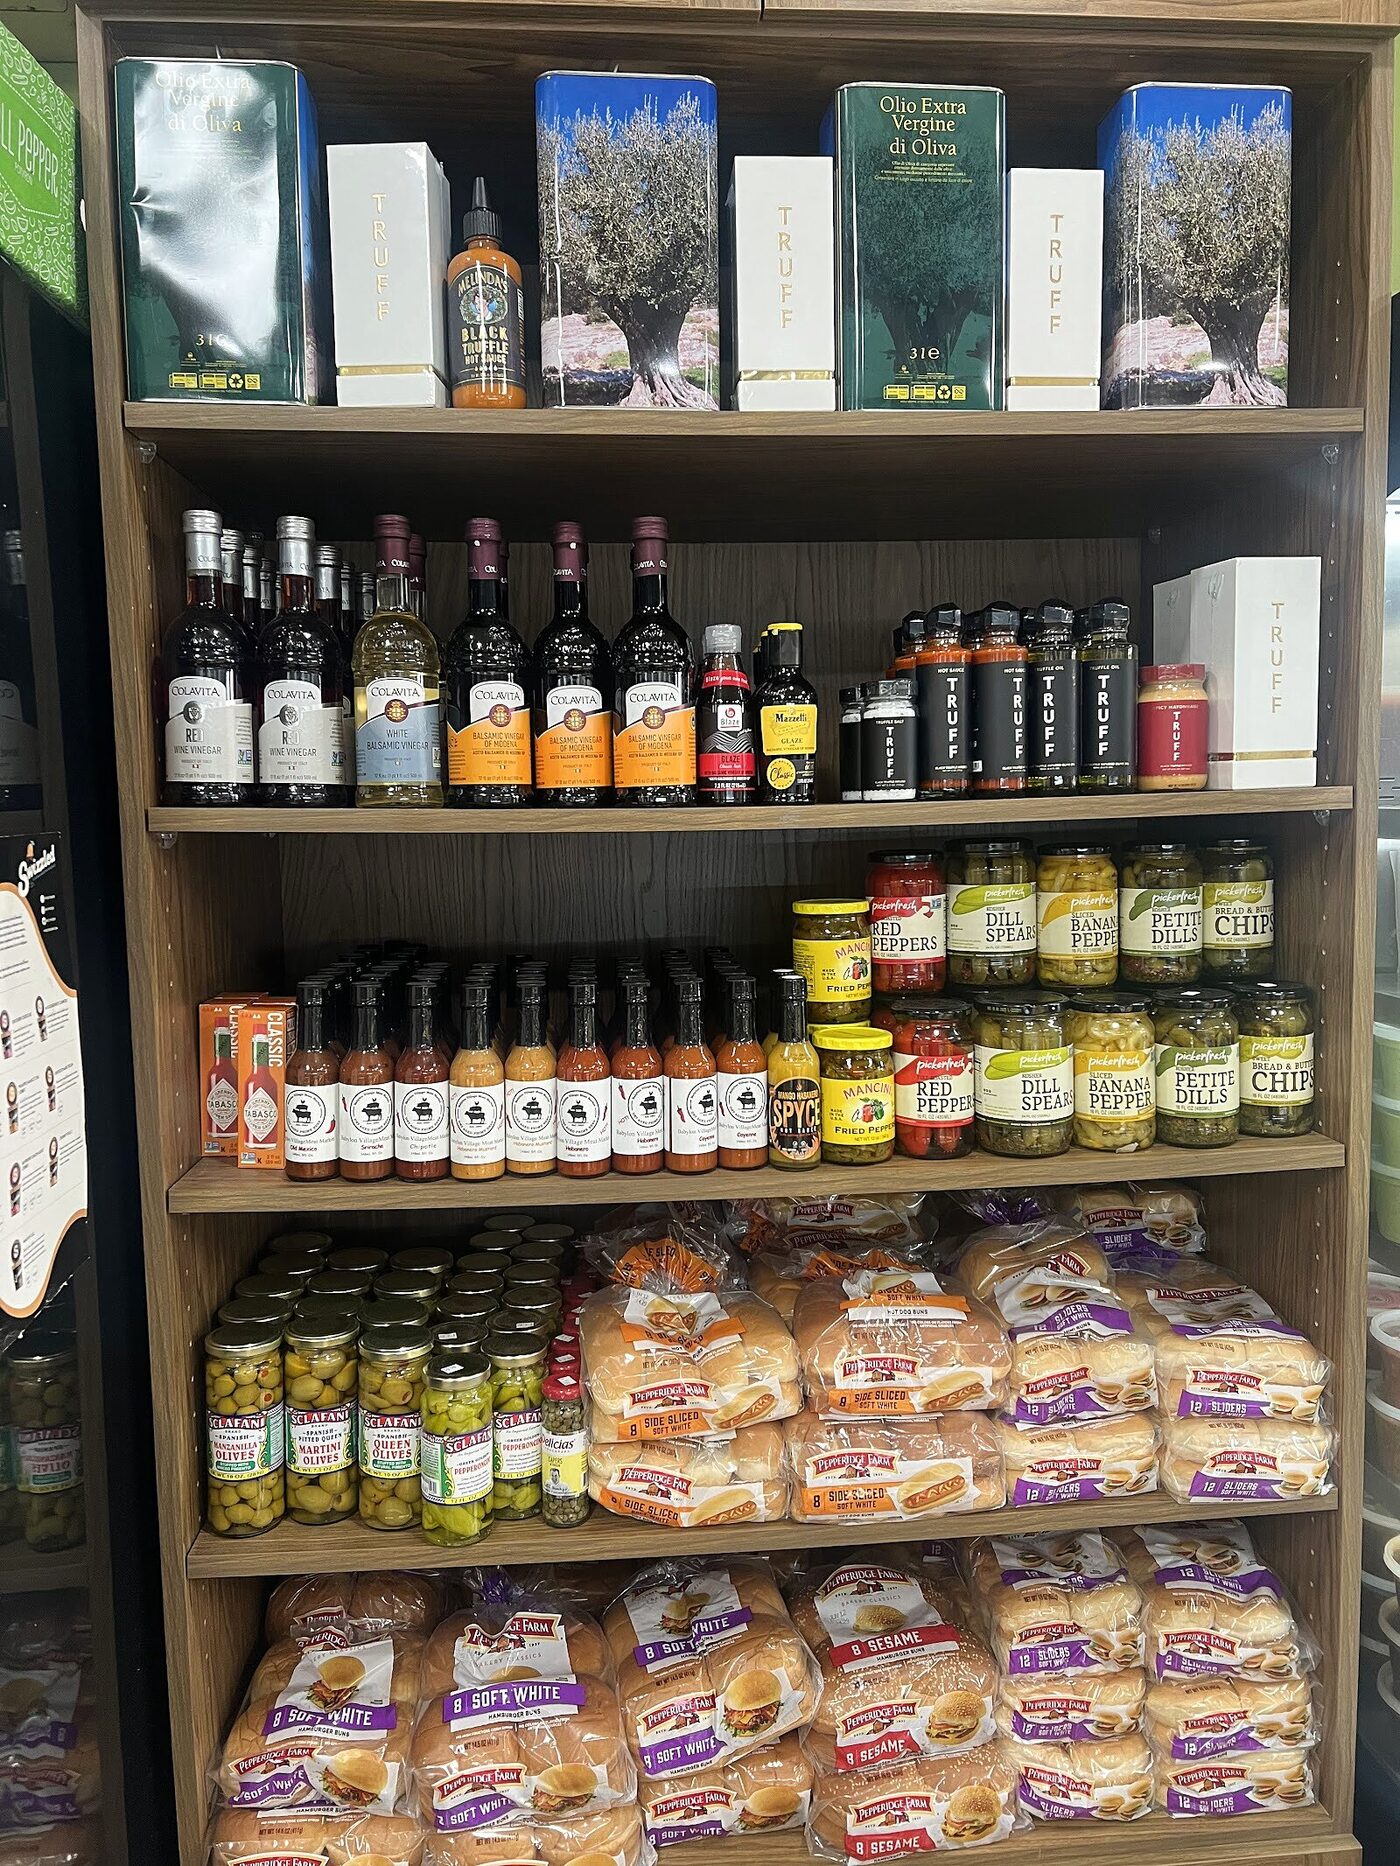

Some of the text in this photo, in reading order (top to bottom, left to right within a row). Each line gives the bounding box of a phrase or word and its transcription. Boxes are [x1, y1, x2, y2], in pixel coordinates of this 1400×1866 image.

[880, 96, 967, 115] Olio Extra
[891, 114, 956, 137] Vergine
[889, 137, 957, 156] di Oliva
[372, 193, 390, 321] TRUFF
[777, 205, 793, 329] TRUFF
[1049, 213, 1064, 334] TRUFF
[461, 325, 509, 342] BLACK
[462, 340, 509, 356] TRUFFLE
[1271, 602, 1285, 714] TRUFF
[172, 686, 220, 697] COLAVITA
[267, 689, 316, 700] COLAVITA
[371, 687, 420, 697] COLAVITA
[475, 690, 521, 701] COLAVITA
[629, 692, 676, 703] COLAVITA
[550, 695, 597, 706] COLAVITA
[720, 718, 740, 726] Blaze
[946, 677, 959, 759] TRUFF
[1012, 677, 1024, 759] TRUFF
[1042, 675, 1055, 758] TRUFF
[1097, 674, 1110, 756] TRUFF
[386, 729, 408, 738] WHITE
[473, 732, 525, 740] BALSAMIC VINEGAR
[1172, 711, 1181, 762] TRUFF
[173, 745, 222, 755] WINE VINEGAR
[269, 747, 317, 757] WINE VINEGAR
[367, 741, 429, 750] BALSAMIC VINEGAR
[484, 740, 518, 748] OF MODENA
[886, 726, 895, 779] TRUFF
[721, 755, 740, 764] GLAZE
[769, 766, 795, 782] Classic
[984, 887, 1025, 902] pickerfresh
[1151, 889, 1200, 908] pickerfresh
[1214, 883, 1265, 902] pickerfresh
[871, 900, 917, 915] pickerfresh
[985, 911, 1024, 927] DILL
[1151, 910, 1202, 928] PETITE
[1214, 913, 1275, 936] CHIPS
[872, 921, 902, 936] RED
[985, 925, 1037, 943] SPEARS
[1151, 927, 1198, 944] DILLS
[872, 936, 938, 952] PEPPERS
[267, 1012, 284, 1067] CLASSIC
[1251, 1037, 1305, 1055] pickerfresh
[916, 1056, 966, 1074] pickerfresh
[1019, 1051, 1063, 1069] pickerfresh
[1088, 1050, 1141, 1071] pickerfresh
[1021, 1078, 1061, 1095] DILL
[1089, 1076, 1151, 1093] BANANA
[1175, 1069, 1235, 1088] PETITE
[1251, 1068, 1314, 1093] CHIPS
[777, 1090, 796, 1100] MANGO
[916, 1081, 952, 1097] RED
[1175, 1088, 1228, 1105] DILLS
[1021, 1089, 1073, 1111] SPEARS
[245, 1109, 277, 1118] TABASCO
[773, 1099, 821, 1129] SPYCE
[1104, 1233, 1132, 1244] SLIDERS
[1061, 1254, 1080, 1274] FARM
[886, 1293, 927, 1302] SOFT WHITE
[1054, 1304, 1089, 1323] SLIDERS
[1028, 1370, 1086, 1392] PEPPERIDGE FARM
[634, 1383, 705, 1402] PEPPERIDGE FARM
[839, 1389, 906, 1407] 8 SIDE SLICED
[859, 1401, 898, 1410] SOFT WHITE
[1027, 1404, 1039, 1416] 12
[1189, 1400, 1247, 1413] 12 SLIDERS
[208, 1416, 266, 1429] SCLAFANI
[291, 1411, 350, 1425] SCLAFANI
[364, 1416, 422, 1429] SCLAFANI
[630, 1411, 699, 1436] 8 SIDE SLICED
[218, 1433, 250, 1441] SPANISH
[306, 1429, 334, 1437] SPANISH
[652, 1422, 692, 1436] SOFT WHITE
[213, 1441, 258, 1451] MANZANILLA
[298, 1433, 343, 1443] PITTED QUEEN
[374, 1439, 411, 1450] QUEEN
[215, 1450, 255, 1461] OLIVES
[299, 1442, 341, 1454] MARTINI
[372, 1450, 412, 1460] OLIVES
[302, 1454, 339, 1466] OLIVES
[817, 1453, 891, 1471] PEPPERIDGE FARM
[1202, 1481, 1258, 1493] 12 SLIDERS
[813, 1487, 885, 1509] 8 SIDE SLICED
[837, 1500, 877, 1510] SOFT WHITE
[624, 1498, 680, 1521] SIDE SLICED
[1180, 1567, 1195, 1578] 12
[522, 1618, 549, 1633] FARM
[1022, 1626, 1062, 1639] PEPPERIDGE
[644, 1616, 731, 1660] 8 SOFT WHITE
[851, 1631, 923, 1656] 8 SESAME
[876, 1647, 926, 1661] HAMBURGER BUNS
[453, 1685, 561, 1714] 8 SOFT WHITE
[273, 1709, 373, 1728] 8 SOFT WHITE
[488, 1708, 541, 1720] HAMBURGER BUNS
[846, 1705, 914, 1730] PEPPERIDGE FARM
[644, 1735, 717, 1770] 8 SOFT WHITE
[846, 1739, 905, 1765] 8 SESAME
[239, 1749, 310, 1773] PEPPERIDGE FARM
[656, 1791, 727, 1815] PEPPERIDGE FARM
[858, 1797, 928, 1821] PEPPERIDGE FARM
[856, 1836, 920, 1855] 8 SESAME
